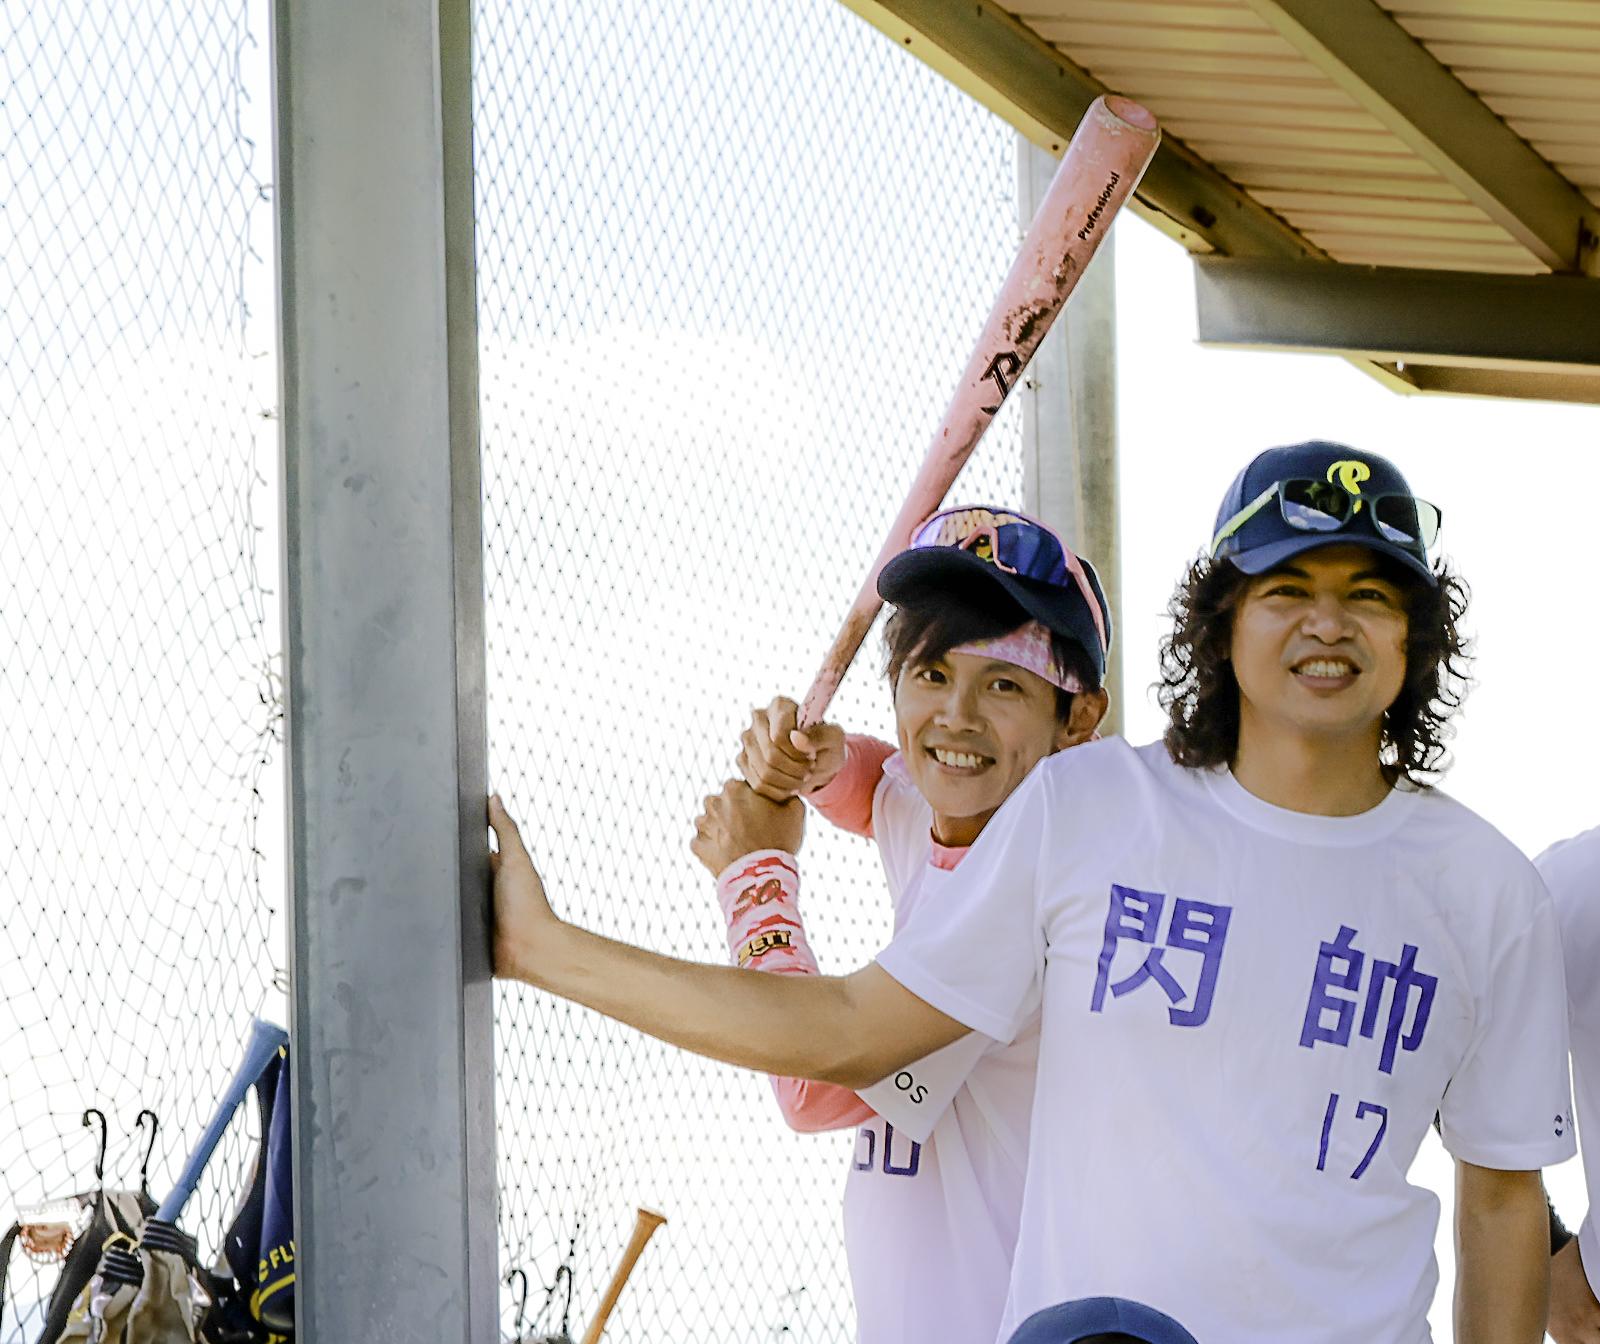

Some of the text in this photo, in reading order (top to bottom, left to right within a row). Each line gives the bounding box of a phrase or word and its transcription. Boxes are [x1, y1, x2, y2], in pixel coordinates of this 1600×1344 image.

[1078, 171, 1121, 241] Professional
[894, 1070, 930, 1105] OS
[1316, 1092, 1389, 1181] 17
